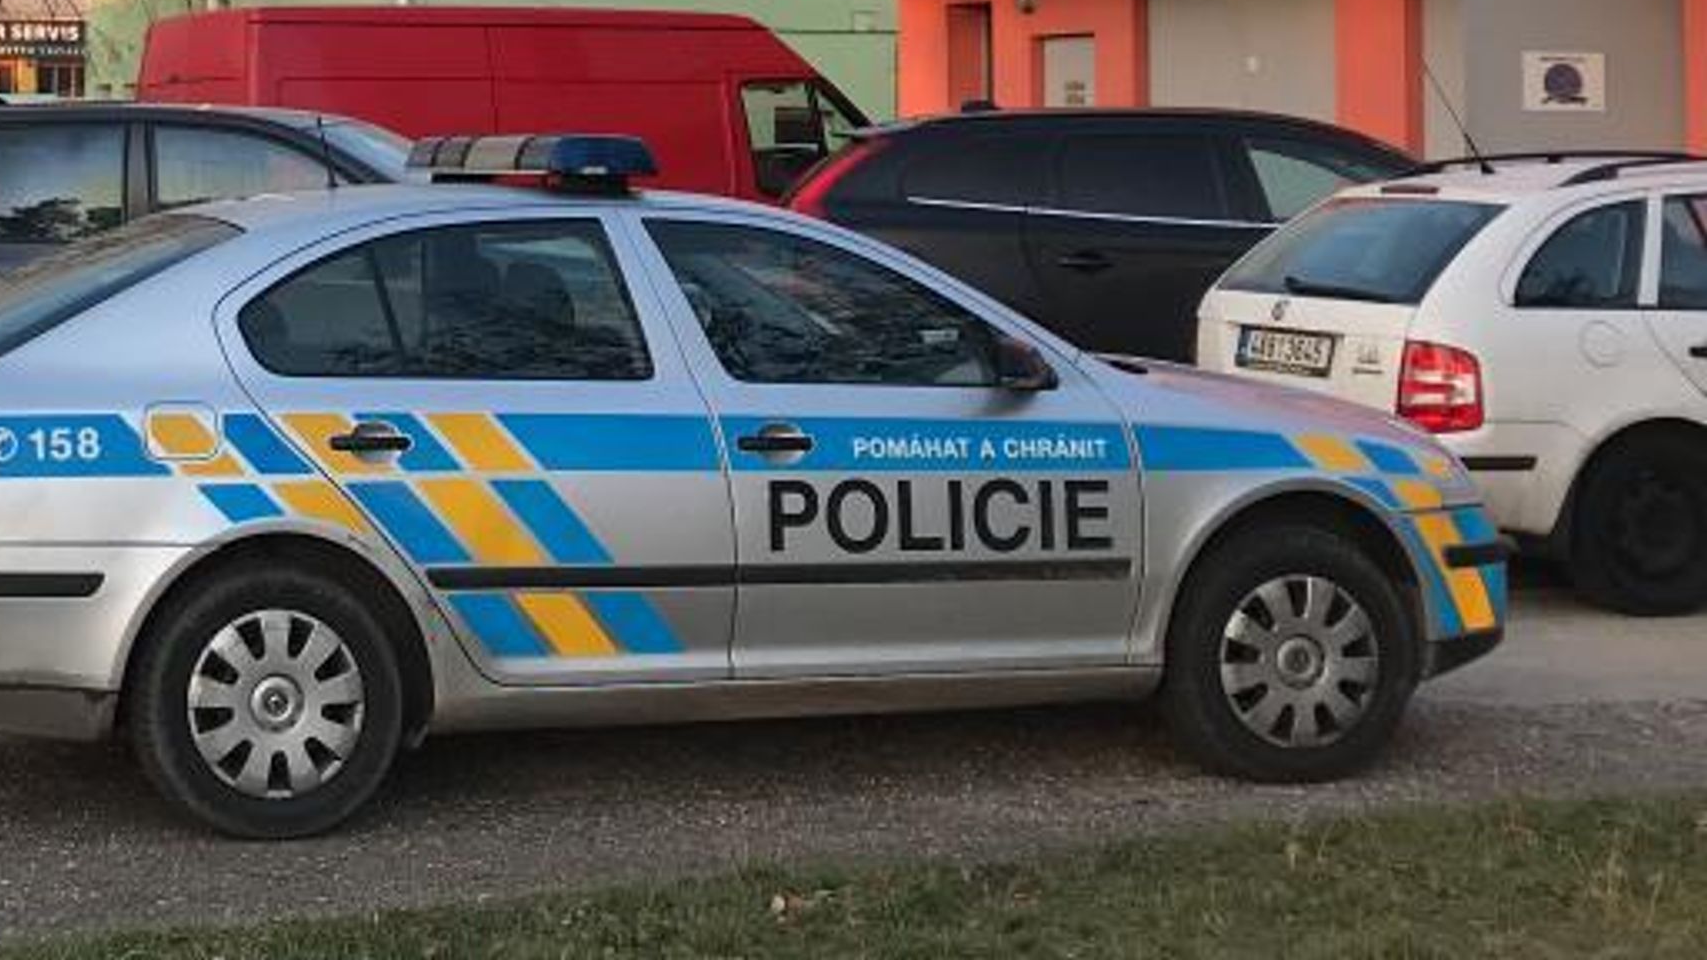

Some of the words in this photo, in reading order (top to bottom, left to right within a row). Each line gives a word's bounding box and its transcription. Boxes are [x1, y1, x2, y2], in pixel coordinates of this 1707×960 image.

[10, 23, 79, 41] SERVIS
[27, 427, 101, 461] 158
[853, 435, 970, 459] POMÁHAT
[980, 440, 997, 460] A
[1003, 436, 1108, 460] CHRÁNIT
[767, 478, 1115, 553] POLICIE
